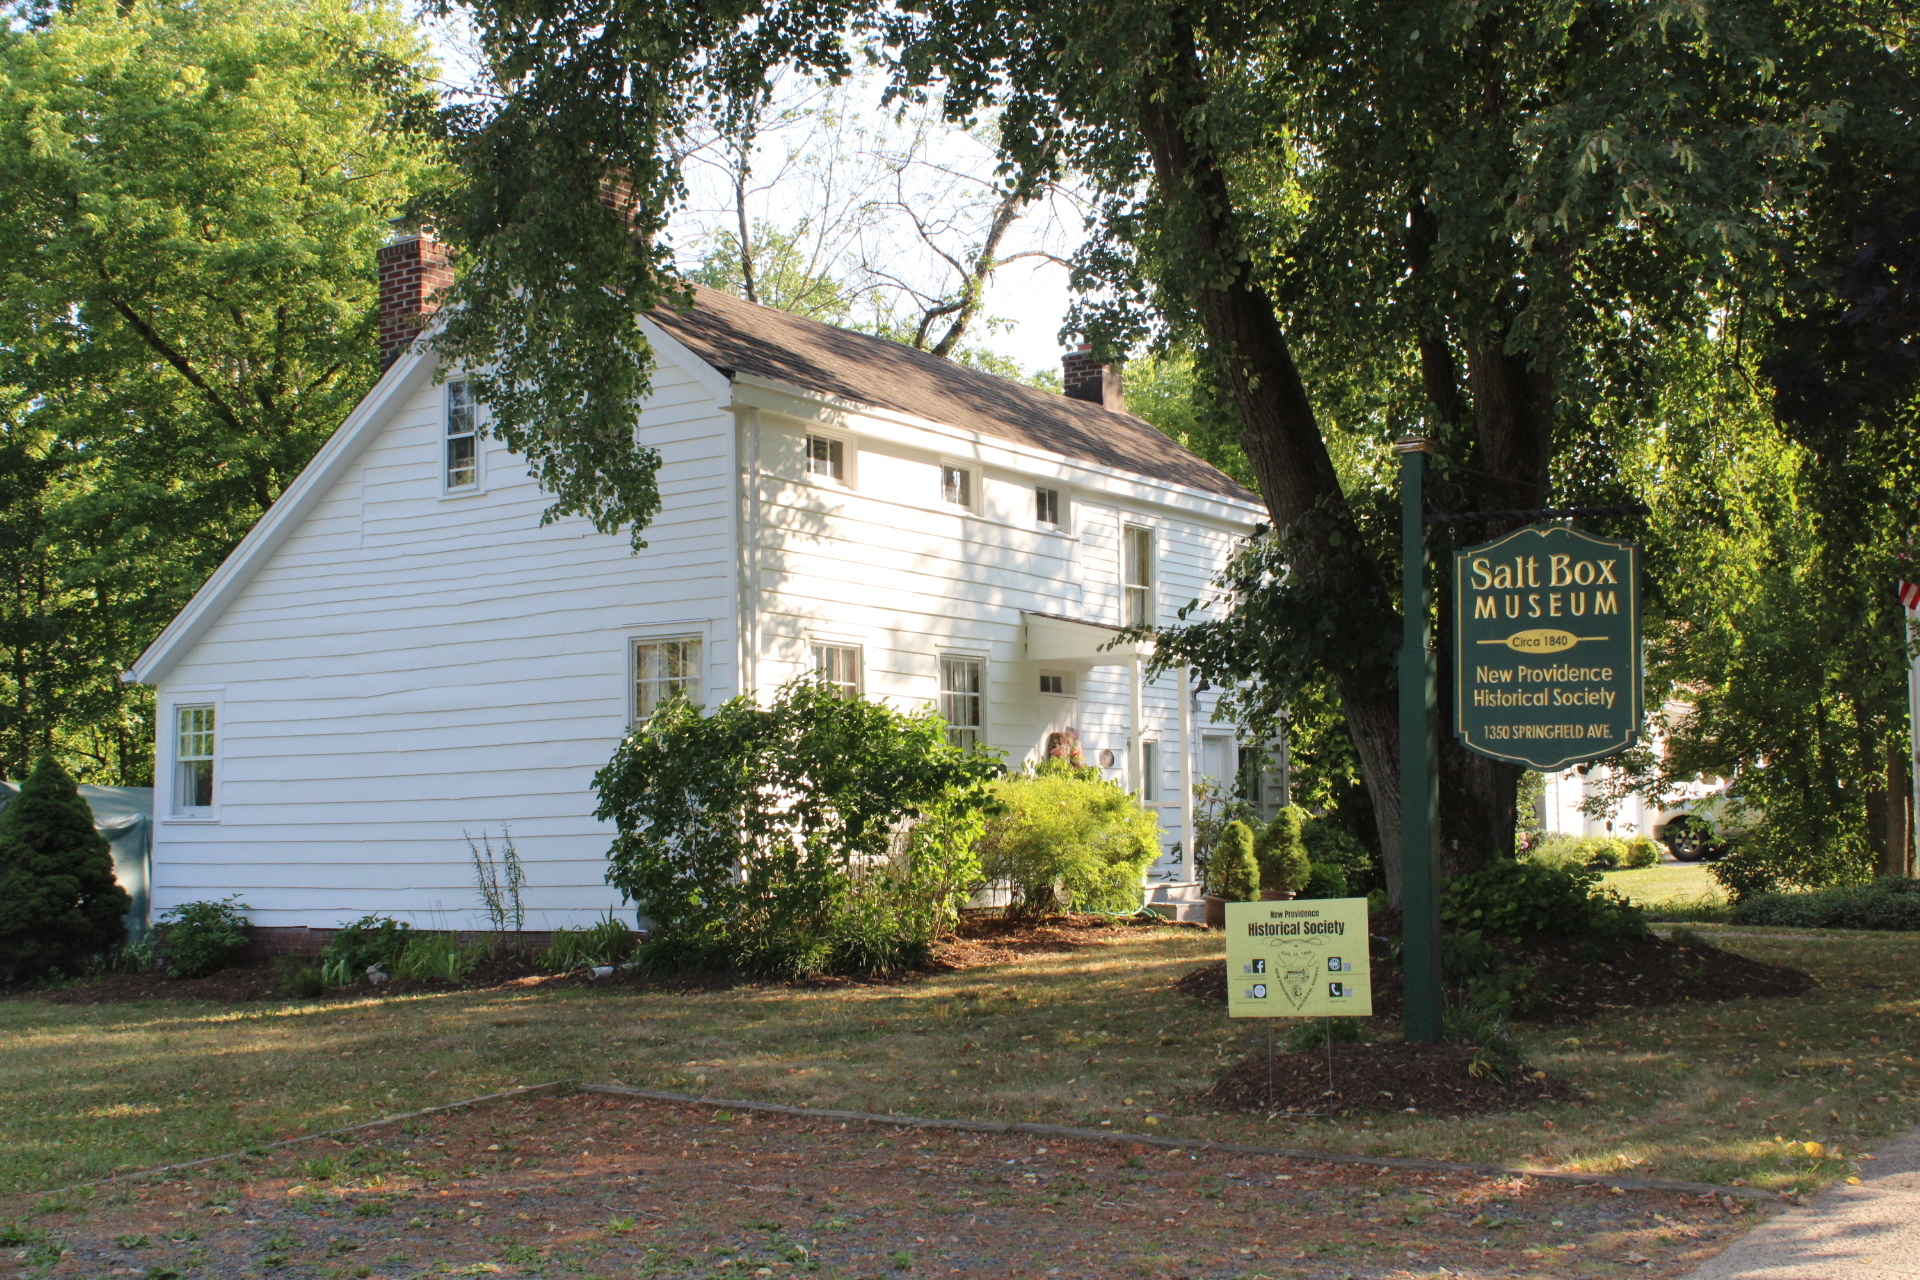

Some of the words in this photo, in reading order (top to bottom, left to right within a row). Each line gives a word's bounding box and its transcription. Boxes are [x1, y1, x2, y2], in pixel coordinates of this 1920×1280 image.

[1471, 555, 1541, 590] Salt
[1548, 553, 1618, 587] Box
[1474, 590, 1618, 619] MUSEUM
[1512, 637, 1540, 647] Circa
[1544, 635, 1568, 646] 1840
[1476, 665, 1513, 684] New
[1518, 663, 1613, 683] Providence
[1474, 687, 1549, 707] Historical
[1553, 686, 1616, 709] Society
[1483, 725, 1510, 740] 1350
[1512, 724, 1584, 740] SPRINGFIELD
[1586, 724, 1613, 739] AVE.
[1270, 911, 1283, 919] New
[1284, 909, 1320, 918] Providence
[1248, 921, 1300, 937] Historical
[1303, 920, 1345, 935] Society
[1279, 979, 1296, 1007] PROVIDENCE
[1296, 986, 1314, 1011] HISTORICAL
[1311, 966, 1320, 987] SOCIETY
